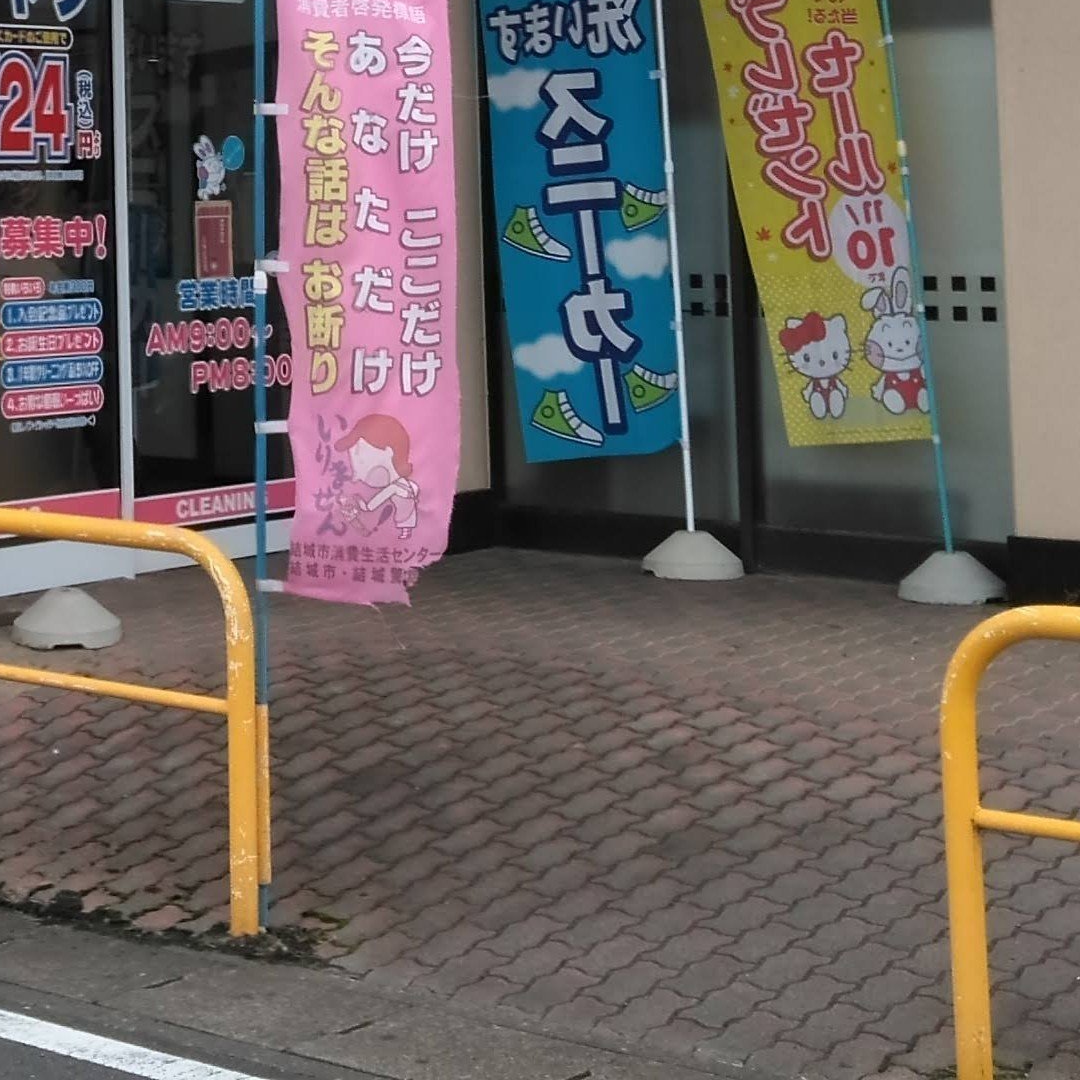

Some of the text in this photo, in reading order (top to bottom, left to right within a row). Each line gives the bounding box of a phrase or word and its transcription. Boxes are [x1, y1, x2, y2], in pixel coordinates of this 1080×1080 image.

[347, 30, 394, 395] あなただけ
[394, 34, 443, 395] 今だけ ここだけ
[176, 489, 269, 519] CLEANIN
